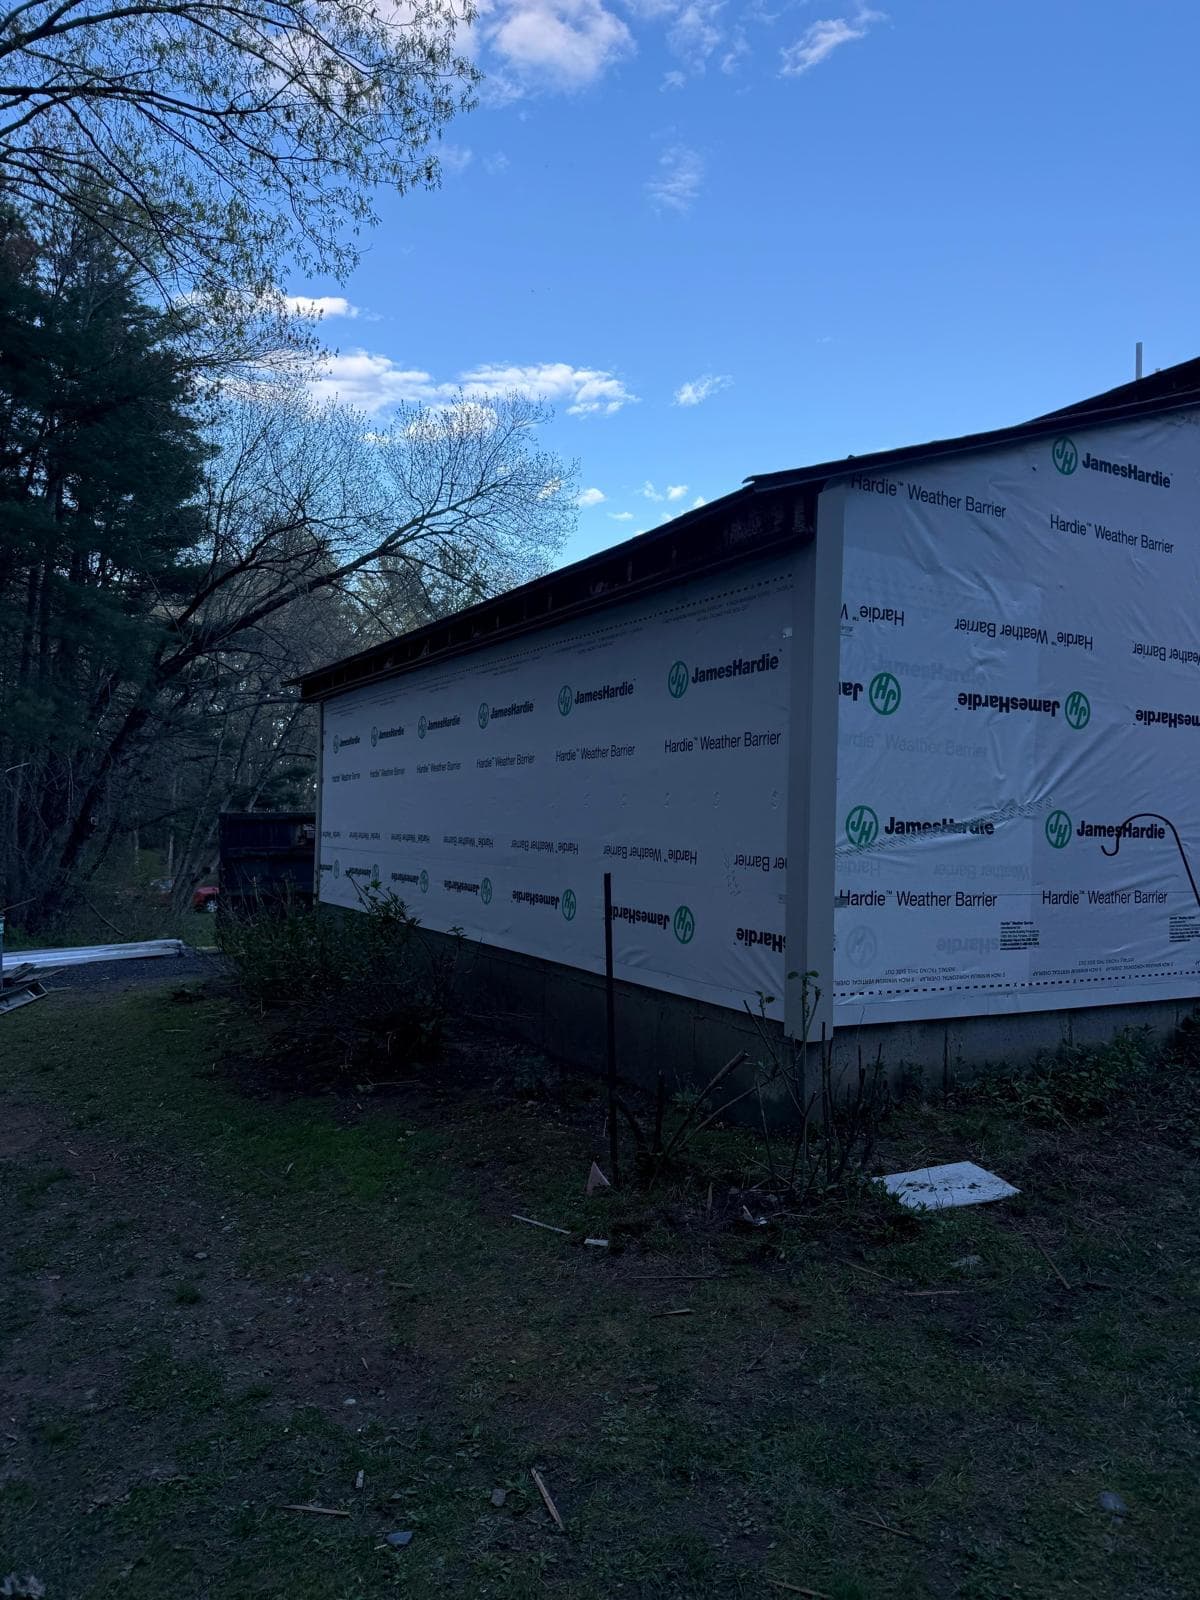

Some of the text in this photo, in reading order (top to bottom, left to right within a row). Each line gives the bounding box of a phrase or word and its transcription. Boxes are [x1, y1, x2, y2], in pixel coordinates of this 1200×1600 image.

[1082, 453, 1172, 488] JamesHardie
[908, 483, 962, 509] Weather
[966, 496, 1006, 518] Barrier
[1094, 524, 1138, 546] Weather
[1141, 534, 1174, 553] Barrier
[954, 618, 996, 638] Barrier
[1000, 624, 1048, 644] Weather
[1132, 643, 1166, 661] Barrier
[692, 653, 779, 683] JamesHardie
[575, 681, 634, 704] JamesHardie
[958, 692, 1060, 717] JamesHardie
[1135, 709, 1200, 728] mesHardie
[700, 735, 741, 751] Weather
[744, 730, 781, 747] Barrier
[580, 745, 609, 760] Weather
[611, 744, 635, 757] Barrier
[1077, 820, 1166, 839] JamesHardie
[603, 845, 627, 858] Barrier
[629, 847, 662, 862] Weather
[734, 854, 769, 871] Barrier
[896, 891, 952, 907] Weather
[956, 891, 998, 907] Barrier
[1088, 891, 1132, 904] Weather
[1134, 890, 1168, 904] Barrier
[610, 905, 670, 930] JamesHard
[736, 928, 786, 952] Hardie
